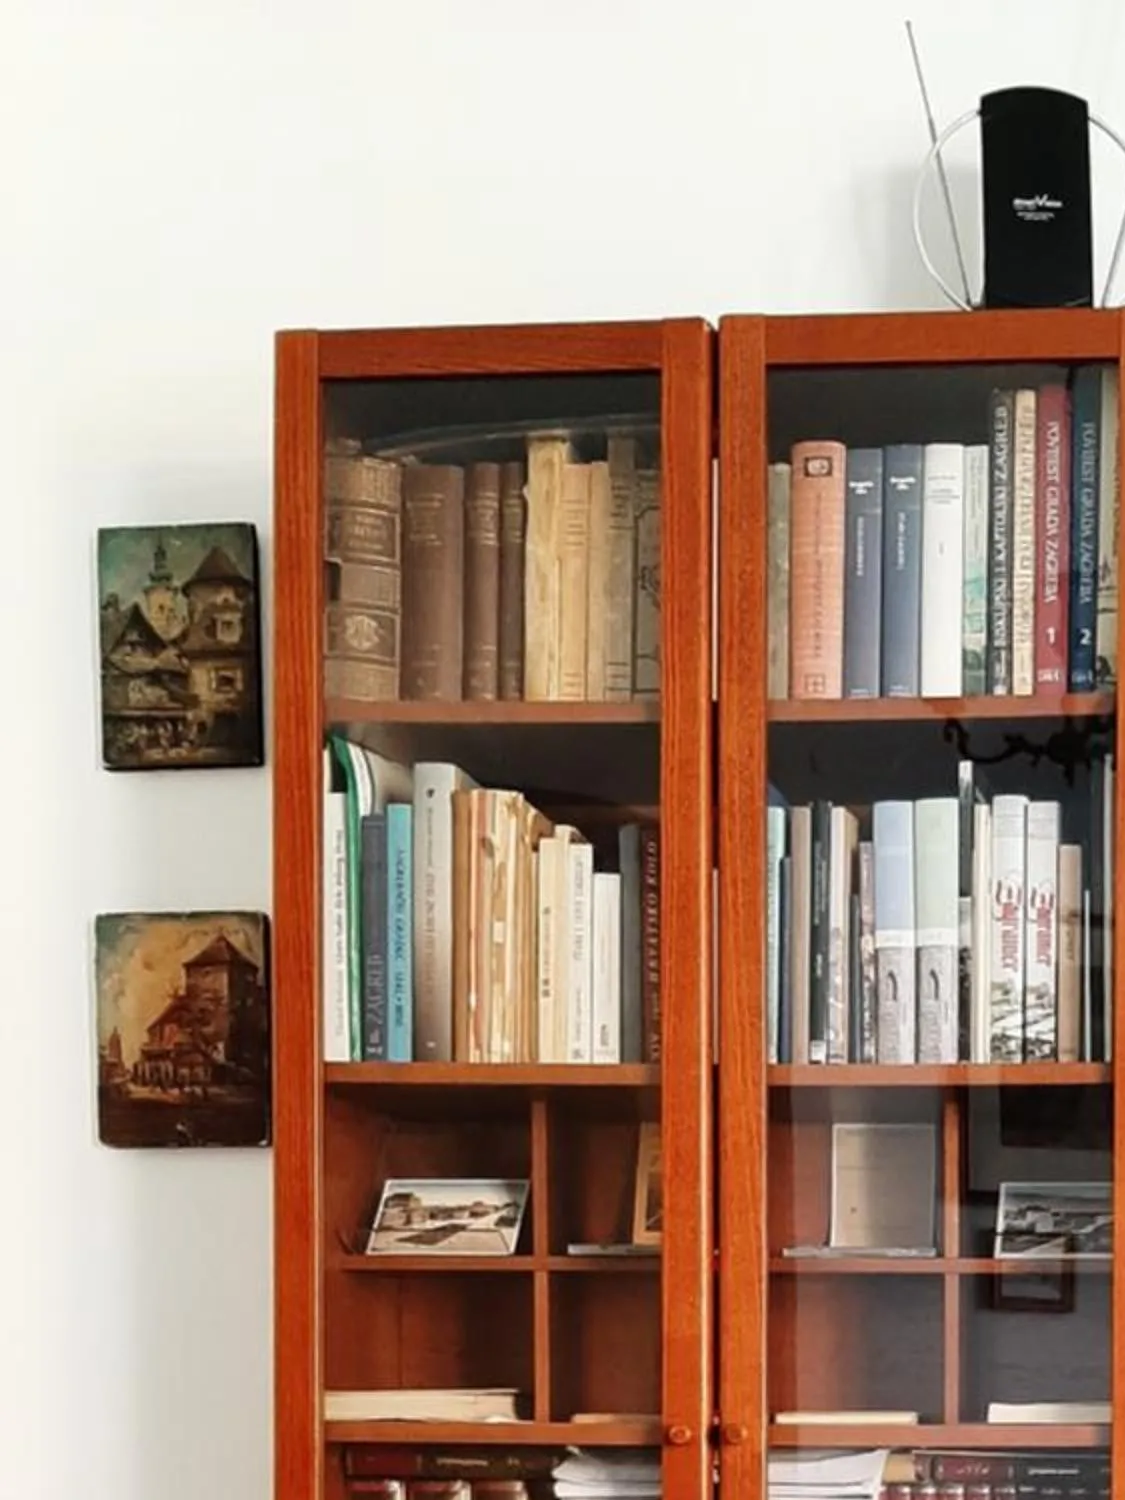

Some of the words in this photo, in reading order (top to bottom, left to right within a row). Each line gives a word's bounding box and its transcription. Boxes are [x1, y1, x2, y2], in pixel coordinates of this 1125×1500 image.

[994, 405, 1008, 481] ZAGREB
[1045, 486, 1060, 536] GRADA
[1080, 487, 1096, 537] GRADA
[1044, 539, 1059, 604] ZAGREBA
[1079, 540, 1095, 605] ZAGREBA
[1046, 628, 1057, 645] 1
[1080, 628, 1092, 646] 2
[646, 840, 657, 886] KOLO
[648, 891, 659, 983] HRVATSKO
